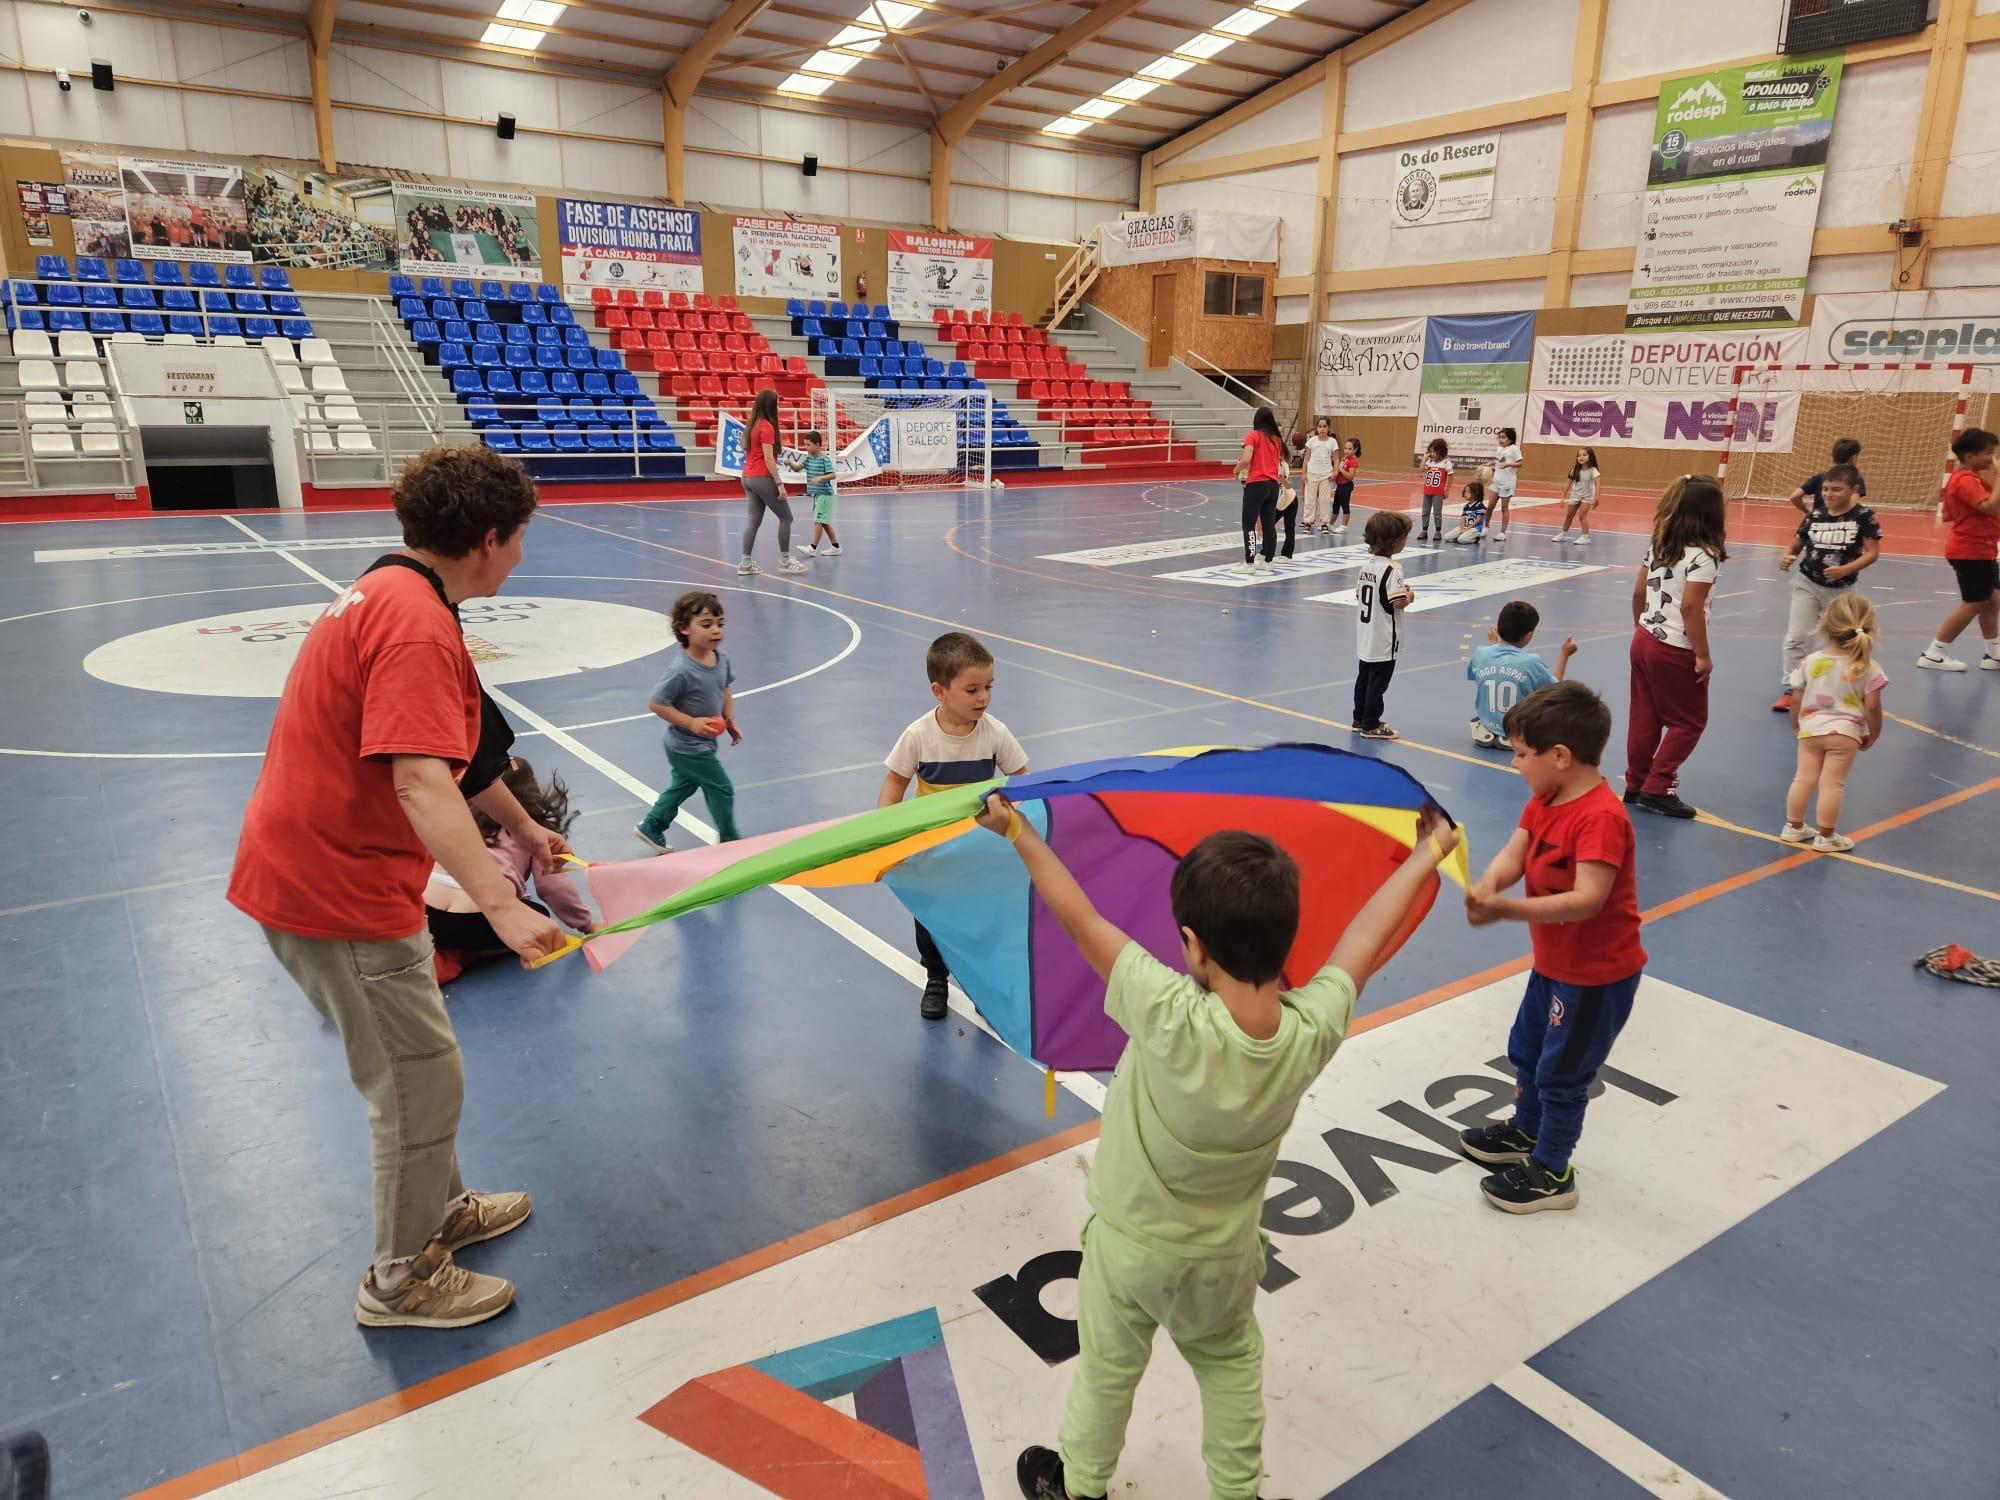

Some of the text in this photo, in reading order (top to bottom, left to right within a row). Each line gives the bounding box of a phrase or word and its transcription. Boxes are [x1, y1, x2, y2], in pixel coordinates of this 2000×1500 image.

[1742, 83, 1809, 97] APOIANDO
[1781, 95, 1814, 111] equipo
[1667, 100, 1727, 123] rodespi
[1665, 137, 1680, 148] 15
[1693, 143, 1736, 156] Servicios
[1738, 136, 1787, 151] integrales
[1400, 142, 1495, 168] Os do Resero
[1712, 152, 1761, 168] en el rural
[395, 182, 453, 194] CONSTRUCCIONS
[1784, 187, 1817, 198] rodespi
[565, 201, 693, 234] FASE DE ASCENSO
[736, 217, 837, 235] FASE DE ASCENSO
[1127, 215, 1174, 235] GRACIAS
[568, 225, 694, 252] DIVISIÓN HONRA PRATA
[751, 230, 789, 239] PRIMERA
[791, 234, 833, 243] NACIONAL
[1659, 229, 1693, 241] Proyectos
[906, 235, 974, 251] BALONMÁN
[595, 248, 634, 260] CAÑIZA
[635, 252, 657, 261] 2021
[918, 246, 965, 256] SECTOR GALEGO
[1756, 266, 1781, 276] aguas
[1635, 289, 1656, 298] VIGO
[1660, 286, 1711, 297] REDONDELA
[1726, 281, 1757, 292] CAÑIZA
[1764, 279, 1801, 289] ORENSE
[1644, 299, 1694, 310] 986 652 144
[1719, 292, 1797, 305] www.rodespi.es
[1672, 313, 1712, 323] INMUEBLE
[1713, 311, 1730, 321] QUE
[1730, 309, 1775, 321] NECESITA!
[1355, 335, 1391, 346] CENTRO
[1392, 335, 1405, 344] DE
[1443, 337, 1511, 351] B the travel brand
[1630, 335, 1782, 364] DEPUTACIÓN
[906, 421, 952, 433] DEPORTE
[1423, 422, 1502, 435] mineraderoc
[906, 434, 948, 446] GALEGO
[1248, 530, 1257, 557] adidas
[1360, 584, 1374, 624] 9
[1478, 665, 1528, 683] IAGO ASPAS
[1484, 679, 1517, 713] 10
